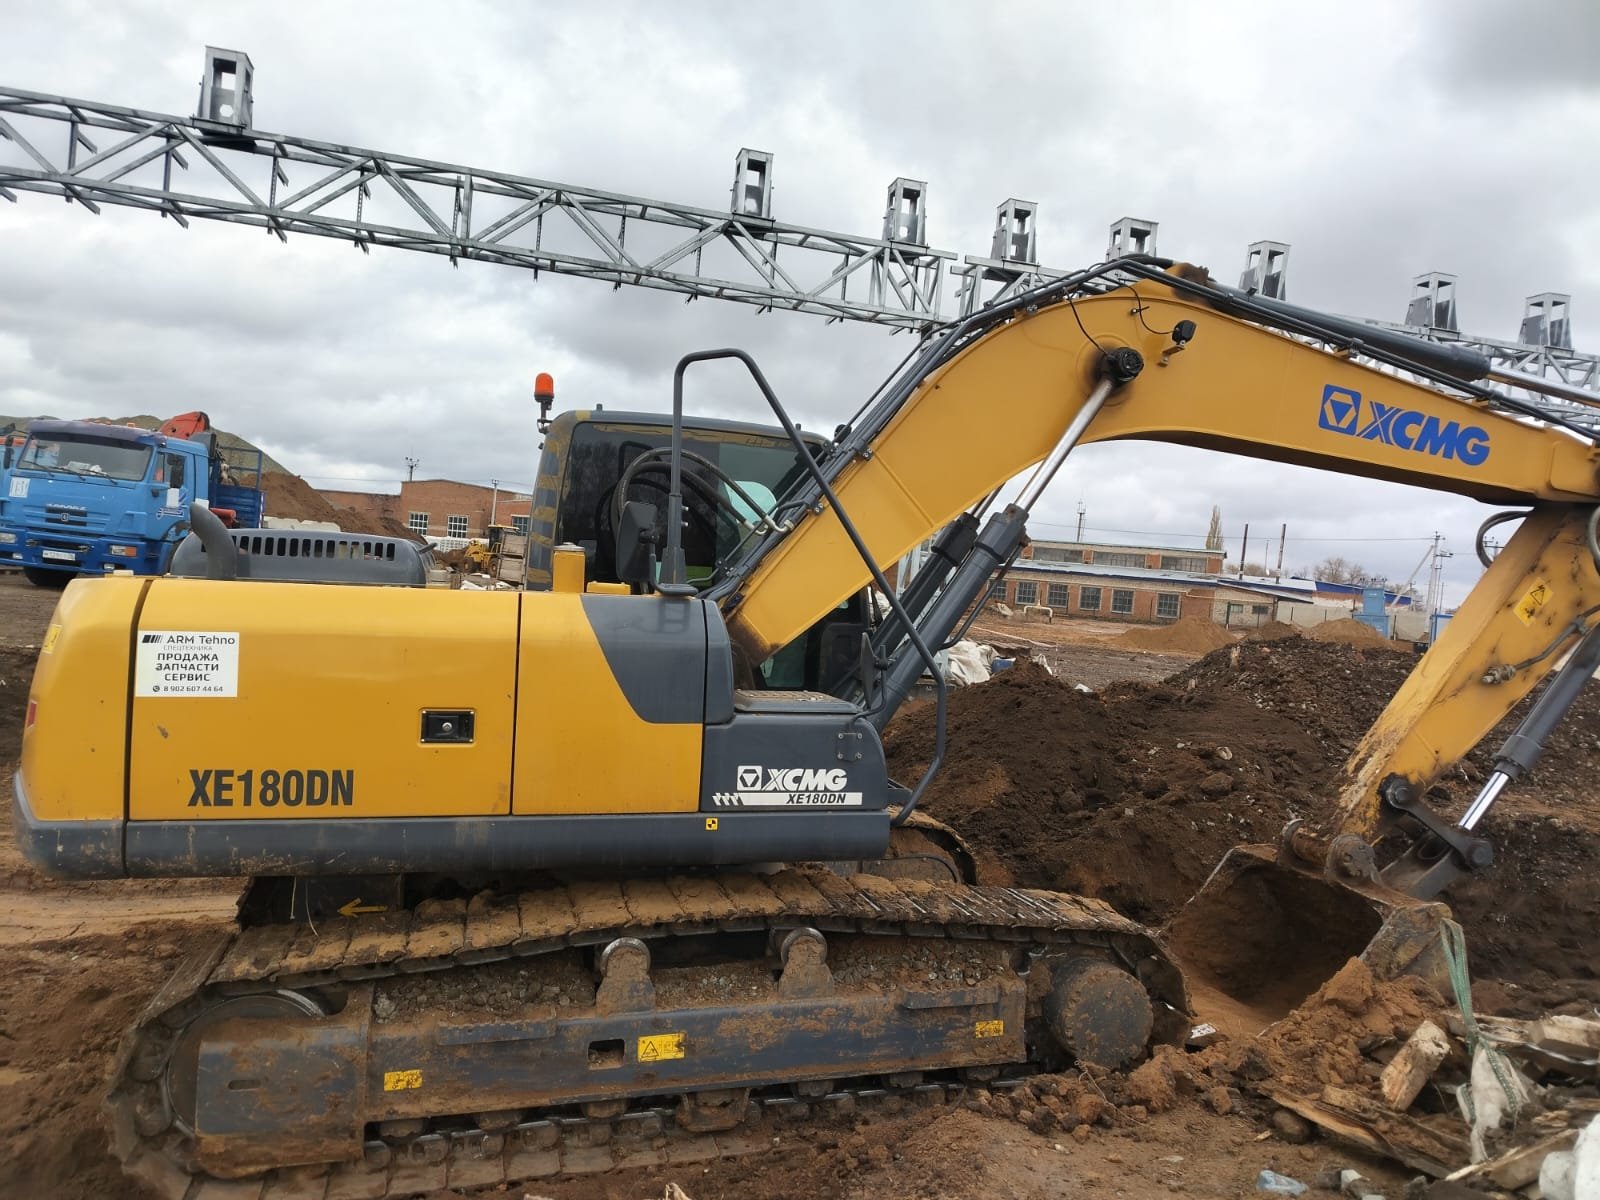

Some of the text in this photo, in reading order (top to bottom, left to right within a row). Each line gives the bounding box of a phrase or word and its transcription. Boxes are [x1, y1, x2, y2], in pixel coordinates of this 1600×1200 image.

[1356, 401, 1490, 466] XCMG
[167, 635, 235, 645] ARM Tehno
[157, 653, 219, 662] ПРОДАЖА
[155, 663, 219, 671] ЗАПЧАСТИ
[164, 673, 211, 682] СЕРВИС
[761, 768, 848, 791] XCMG
[187, 769, 354, 807] XE180DN
[786, 793, 847, 805] XE180DN
